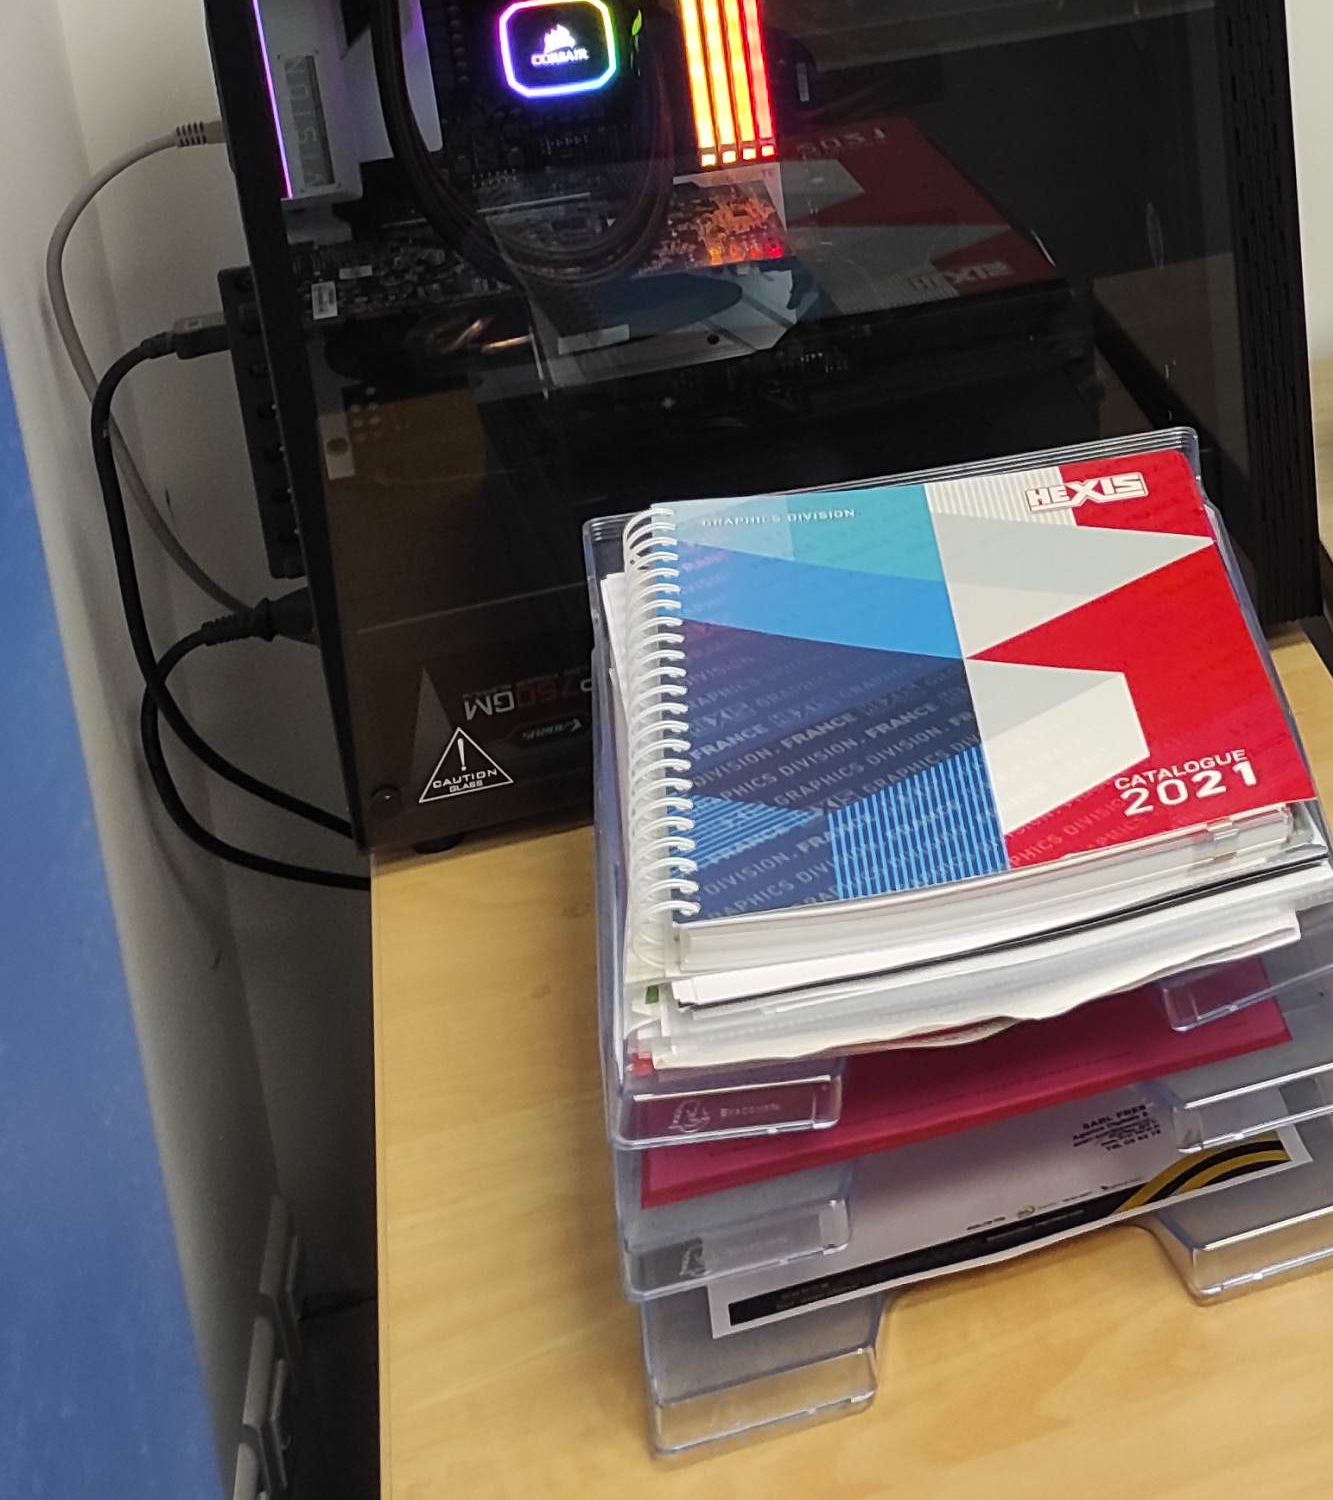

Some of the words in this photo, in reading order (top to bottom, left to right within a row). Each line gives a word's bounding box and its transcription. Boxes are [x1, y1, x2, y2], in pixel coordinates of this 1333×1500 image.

[1026, 473, 1148, 511] HEXIS
[702, 513, 782, 528] GRAPHICS
[786, 508, 856, 524] DIVISION
[781, 711, 857, 749] FRANCE
[865, 701, 940, 740] FRANCE
[690, 723, 769, 762] FRANCE
[432, 767, 498, 789] CAUTION
[449, 779, 484, 793] GLASS
[773, 760, 864, 807] GRAPHICS
[862, 748, 949, 795] GRAPHICS
[1113, 748, 1247, 791] CATALOGUE
[1119, 760, 1258, 817] 2021
